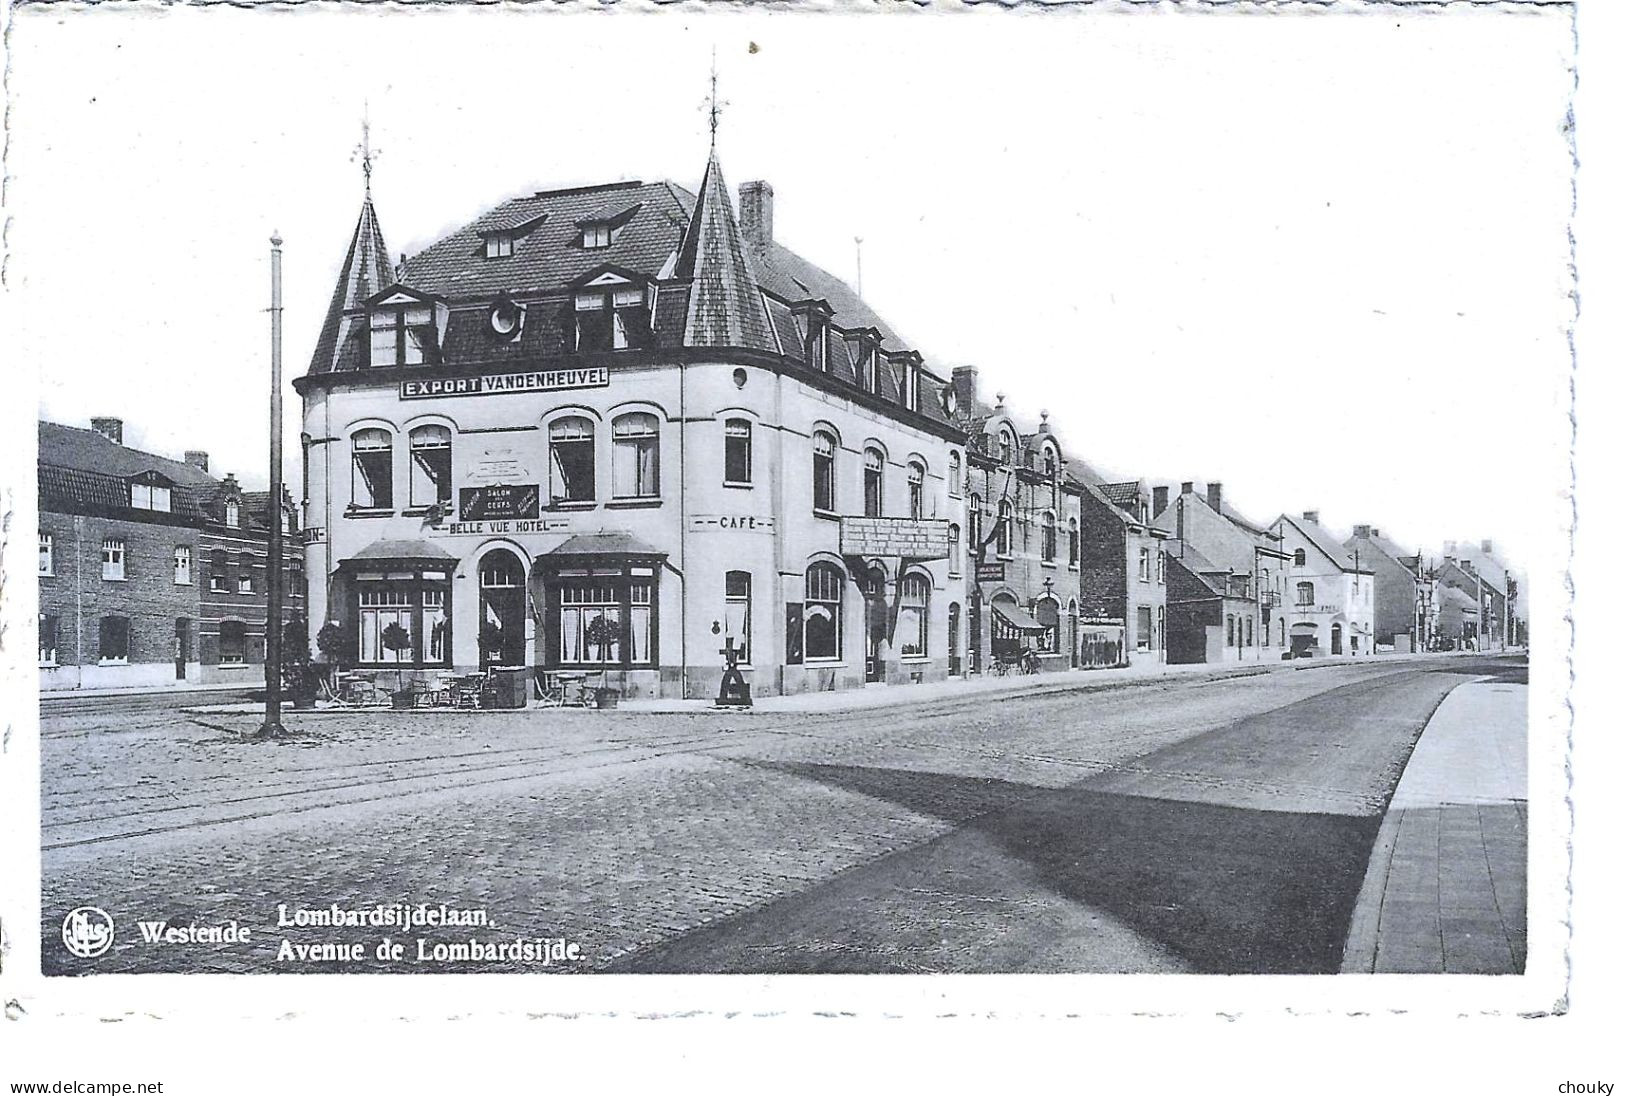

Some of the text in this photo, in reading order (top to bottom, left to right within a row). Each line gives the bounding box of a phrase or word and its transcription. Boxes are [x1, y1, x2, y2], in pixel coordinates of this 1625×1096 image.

[406, 368, 608, 396] EXPORT VANDENHEUVEL
[449, 520, 550, 535] BELLE VUE HOTEL
